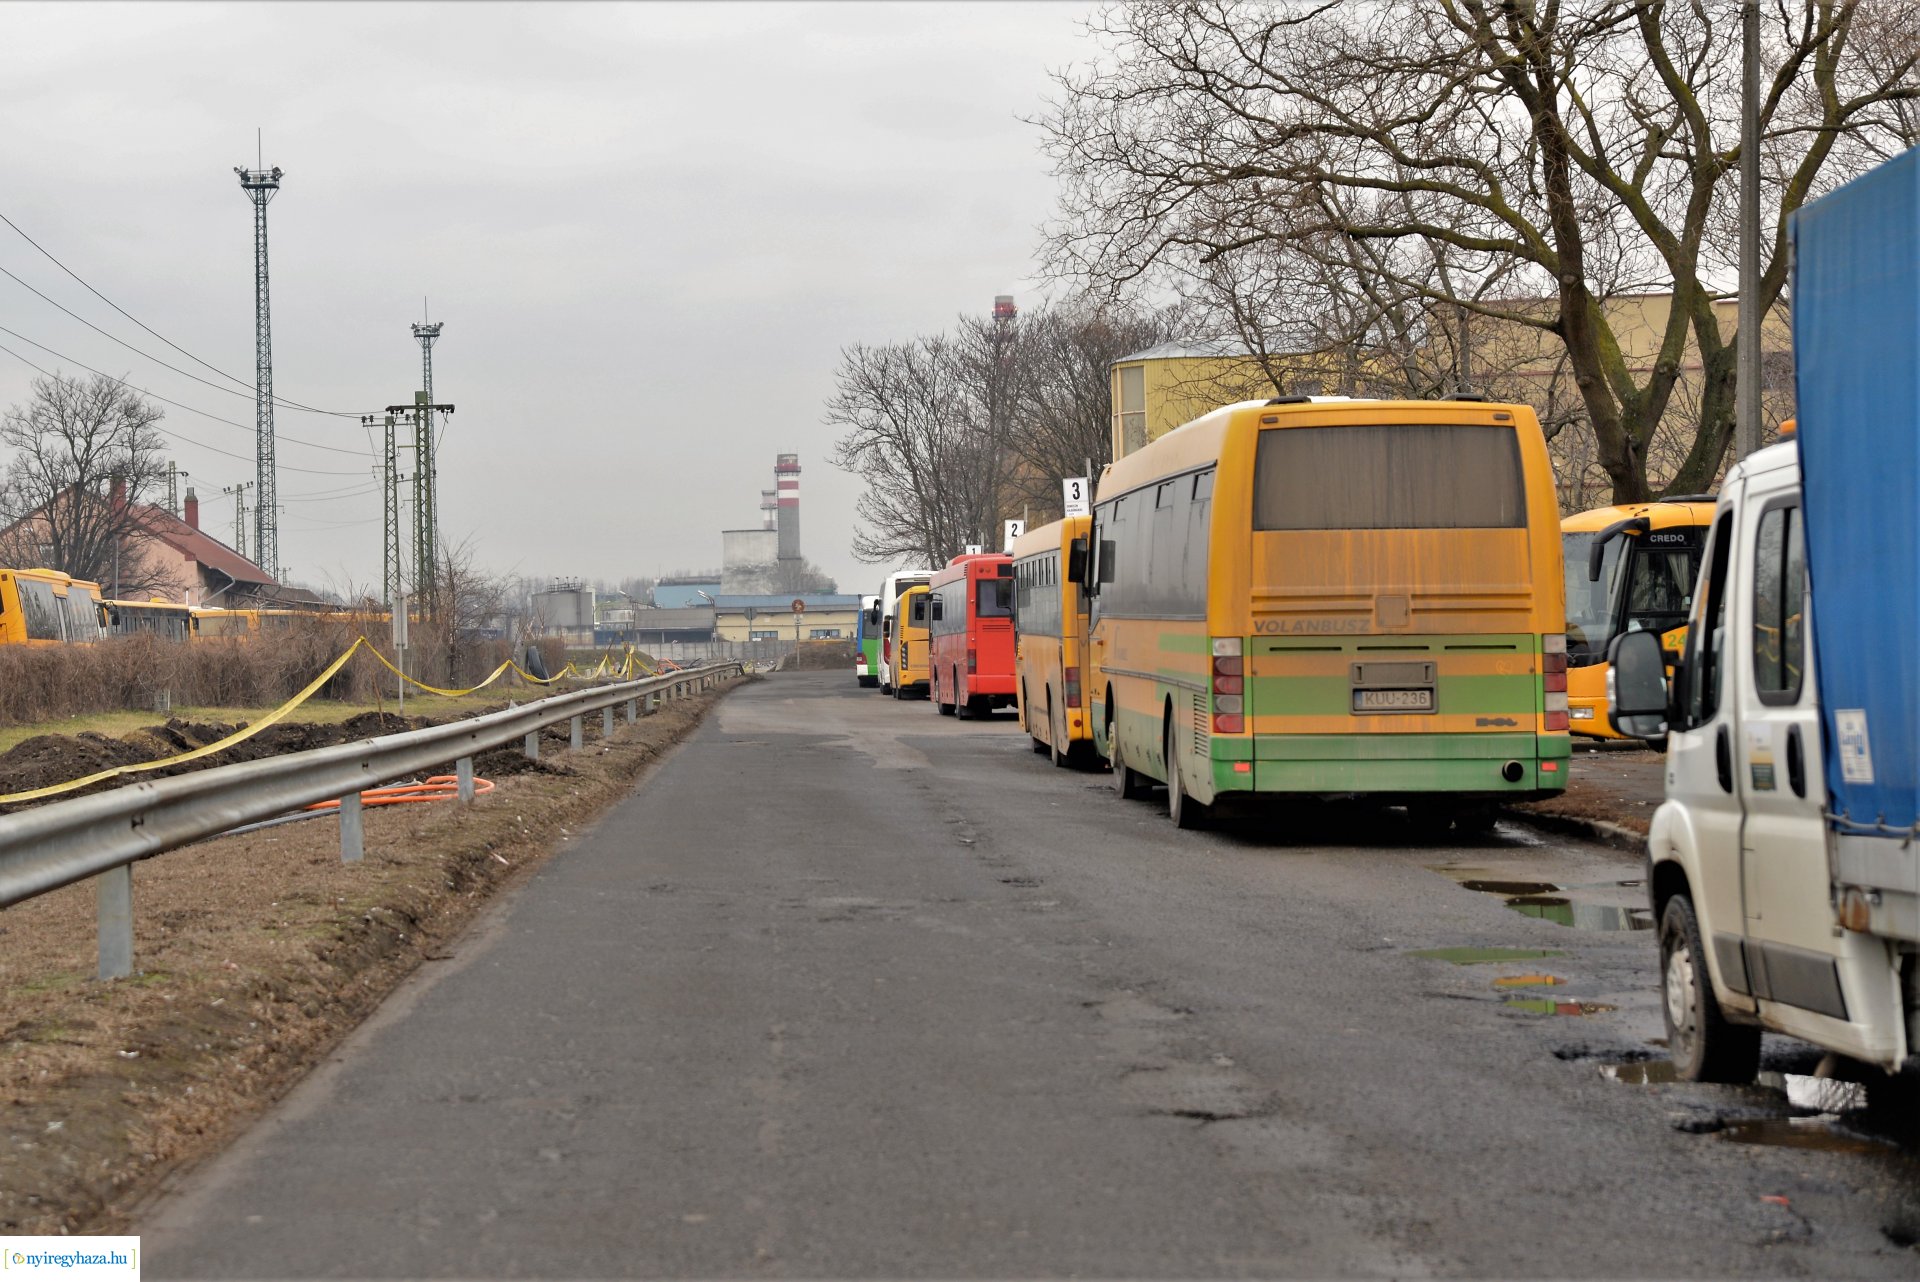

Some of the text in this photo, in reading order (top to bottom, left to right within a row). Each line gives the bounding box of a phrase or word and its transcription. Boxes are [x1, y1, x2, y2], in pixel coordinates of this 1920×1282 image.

[1071, 481, 1081, 500] 3
[1011, 523, 1018, 538] 2
[1649, 534, 1685, 543] CREDO
[1364, 691, 1428, 705] KUU-236
